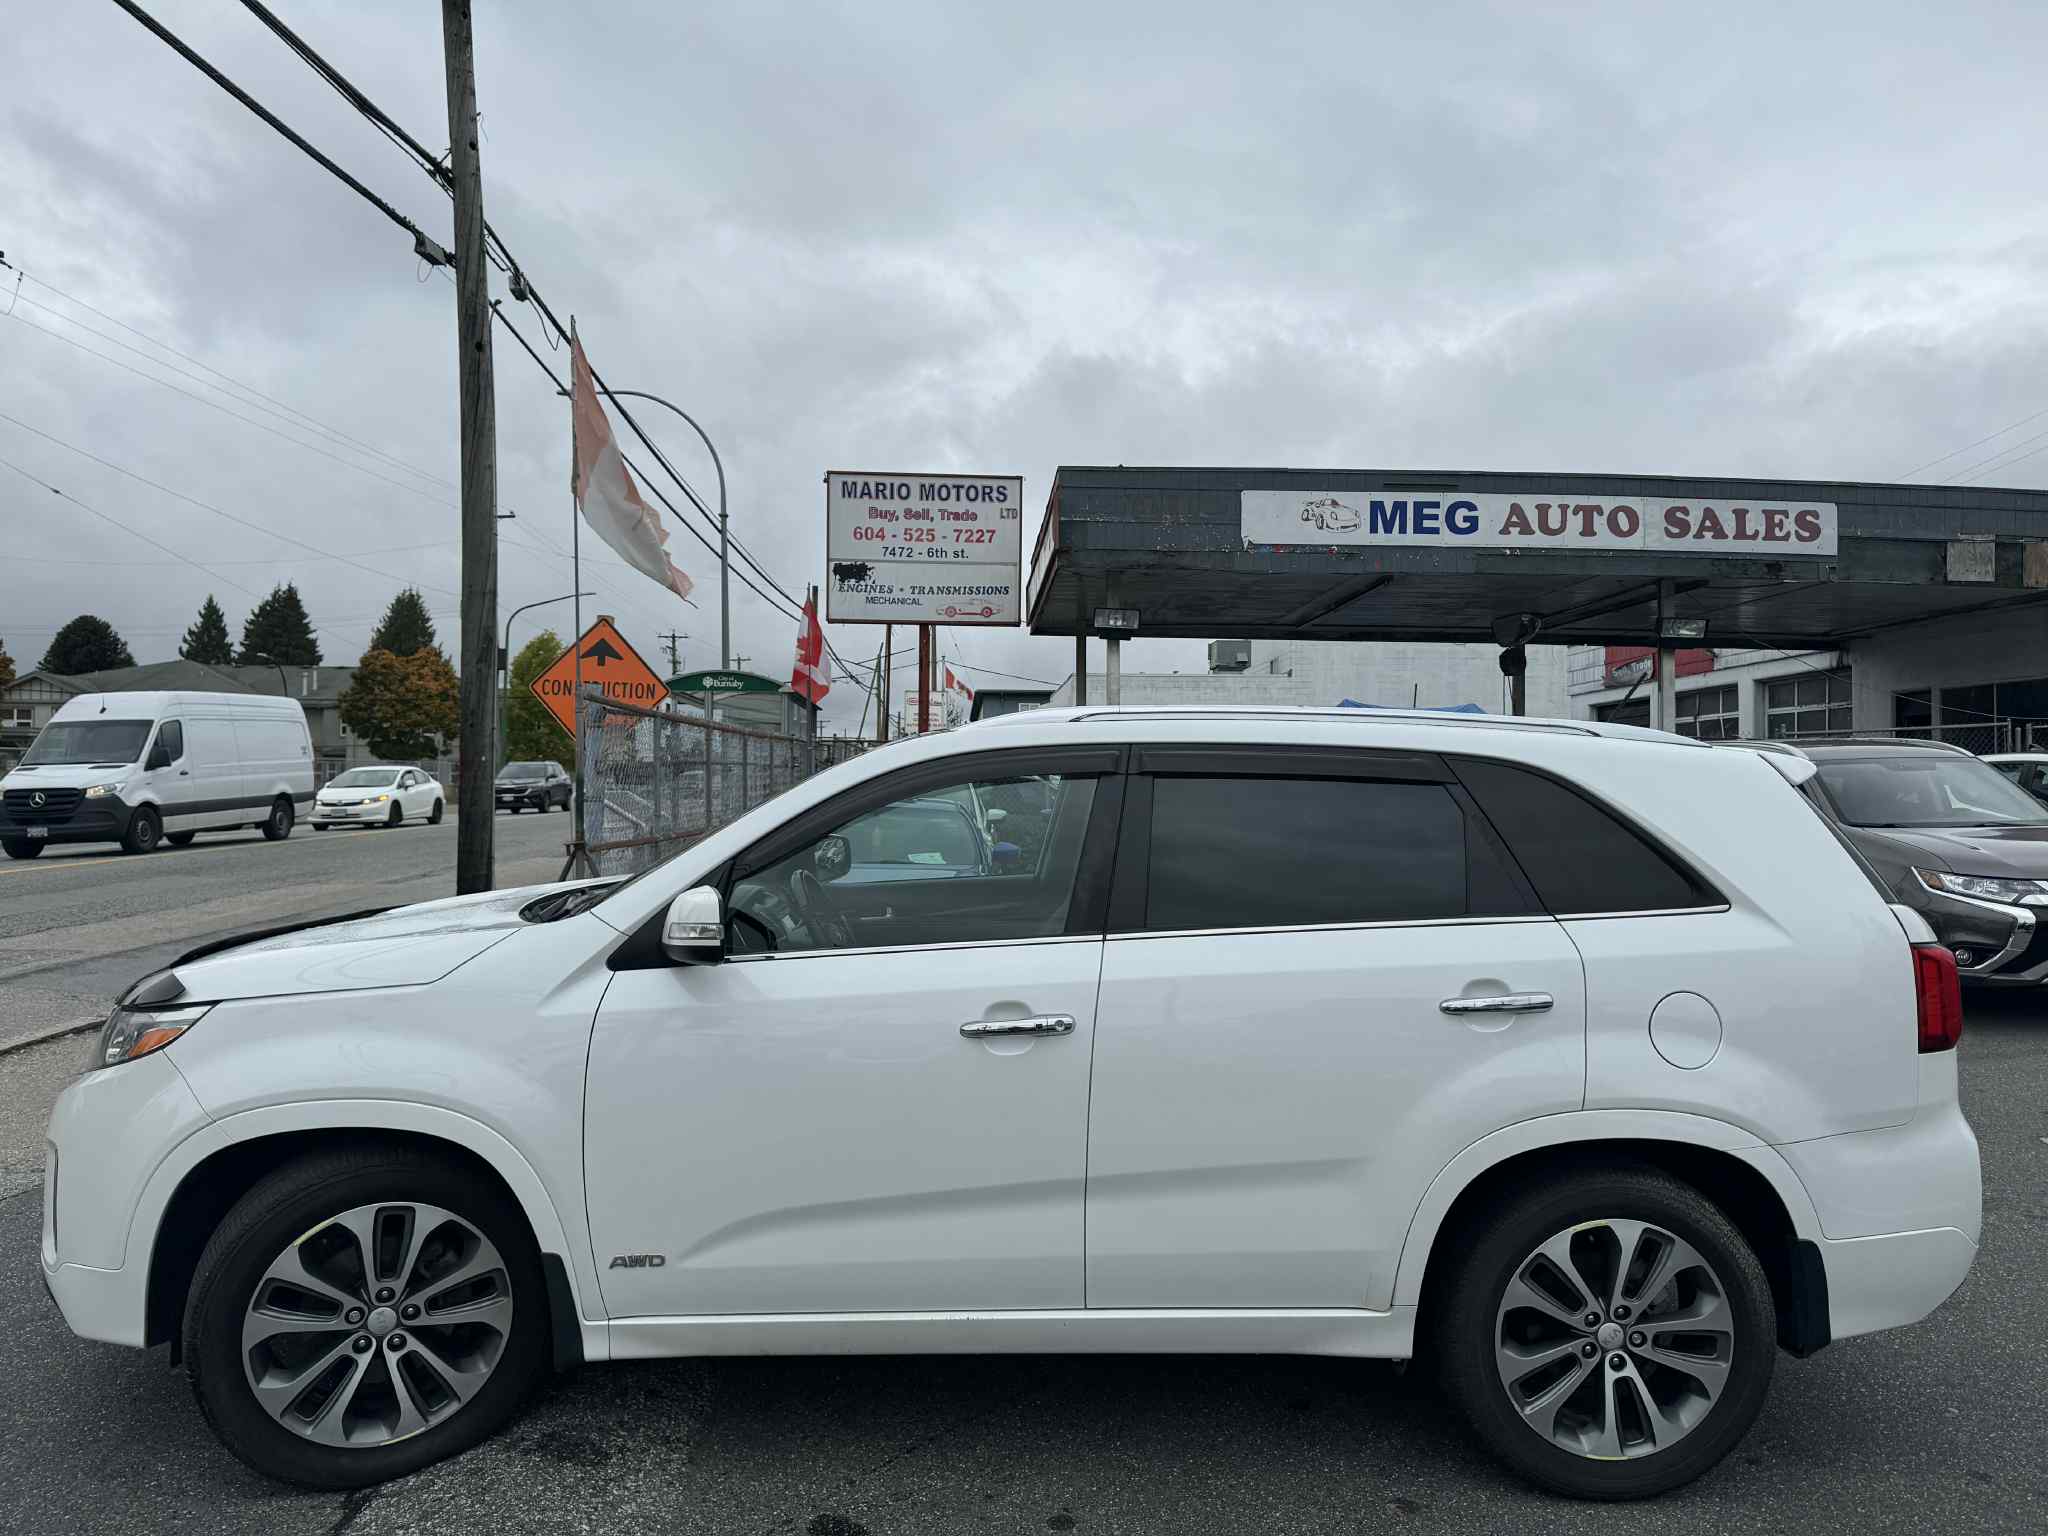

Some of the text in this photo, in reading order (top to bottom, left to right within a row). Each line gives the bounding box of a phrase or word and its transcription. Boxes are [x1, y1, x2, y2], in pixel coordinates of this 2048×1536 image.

[841, 480, 1008, 503] MARIO MOTORS
[868, 506, 978, 523] Buy, Sell, Trade
[999, 507, 1018, 520] LTD
[1369, 500, 1822, 542] MEG AUTO SALES
[852, 526, 886, 542] 604
[903, 528, 936, 543] 525
[953, 528, 996, 544] 7227
[881, 546, 913, 559] 7472
[927, 547, 948, 559] 6th
[952, 548, 969, 559] st.
[838, 583, 1010, 596] ENGINES TRANSMISSIONS
[865, 596, 923, 606] MECHANICAL
[542, 679, 656, 699] CONUCTION
[713, 679, 744, 689] Burnaby
[608, 1254, 666, 1270] AWD
